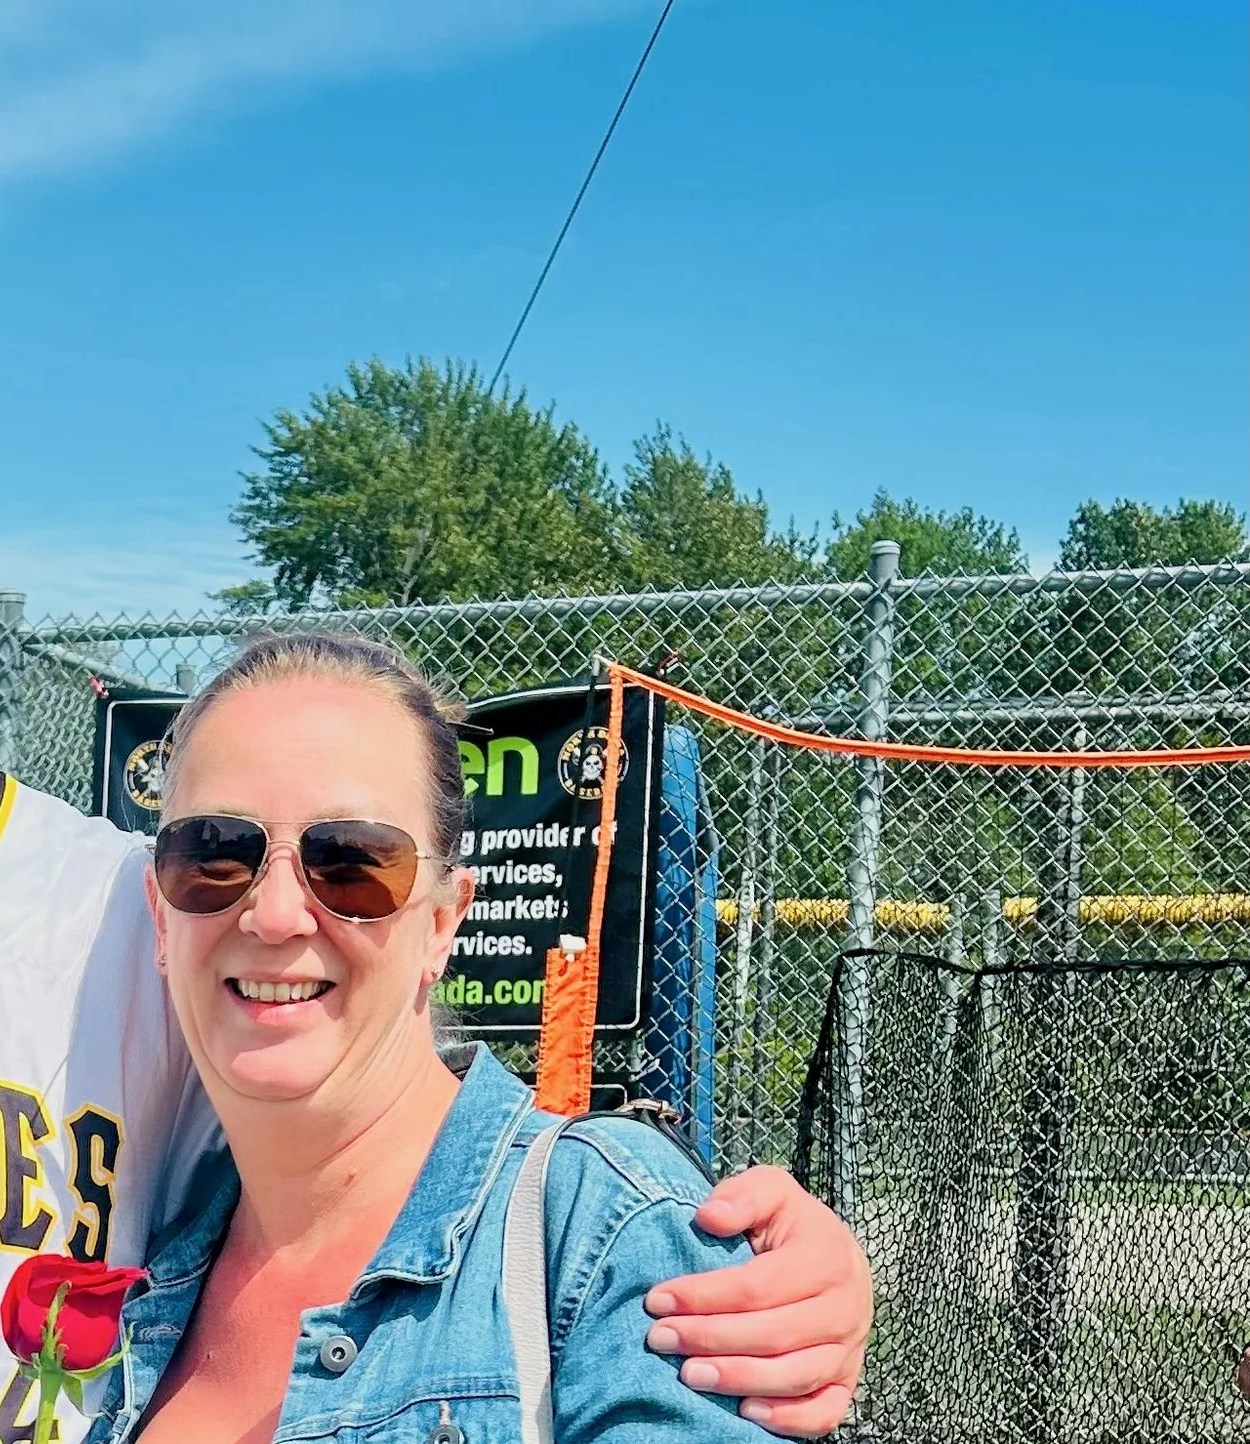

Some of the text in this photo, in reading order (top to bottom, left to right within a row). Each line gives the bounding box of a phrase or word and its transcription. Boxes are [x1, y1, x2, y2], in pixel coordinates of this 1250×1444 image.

[481, 822, 586, 856] provider
[471, 859, 563, 888] ervices,
[452, 930, 533, 956] rvices.
